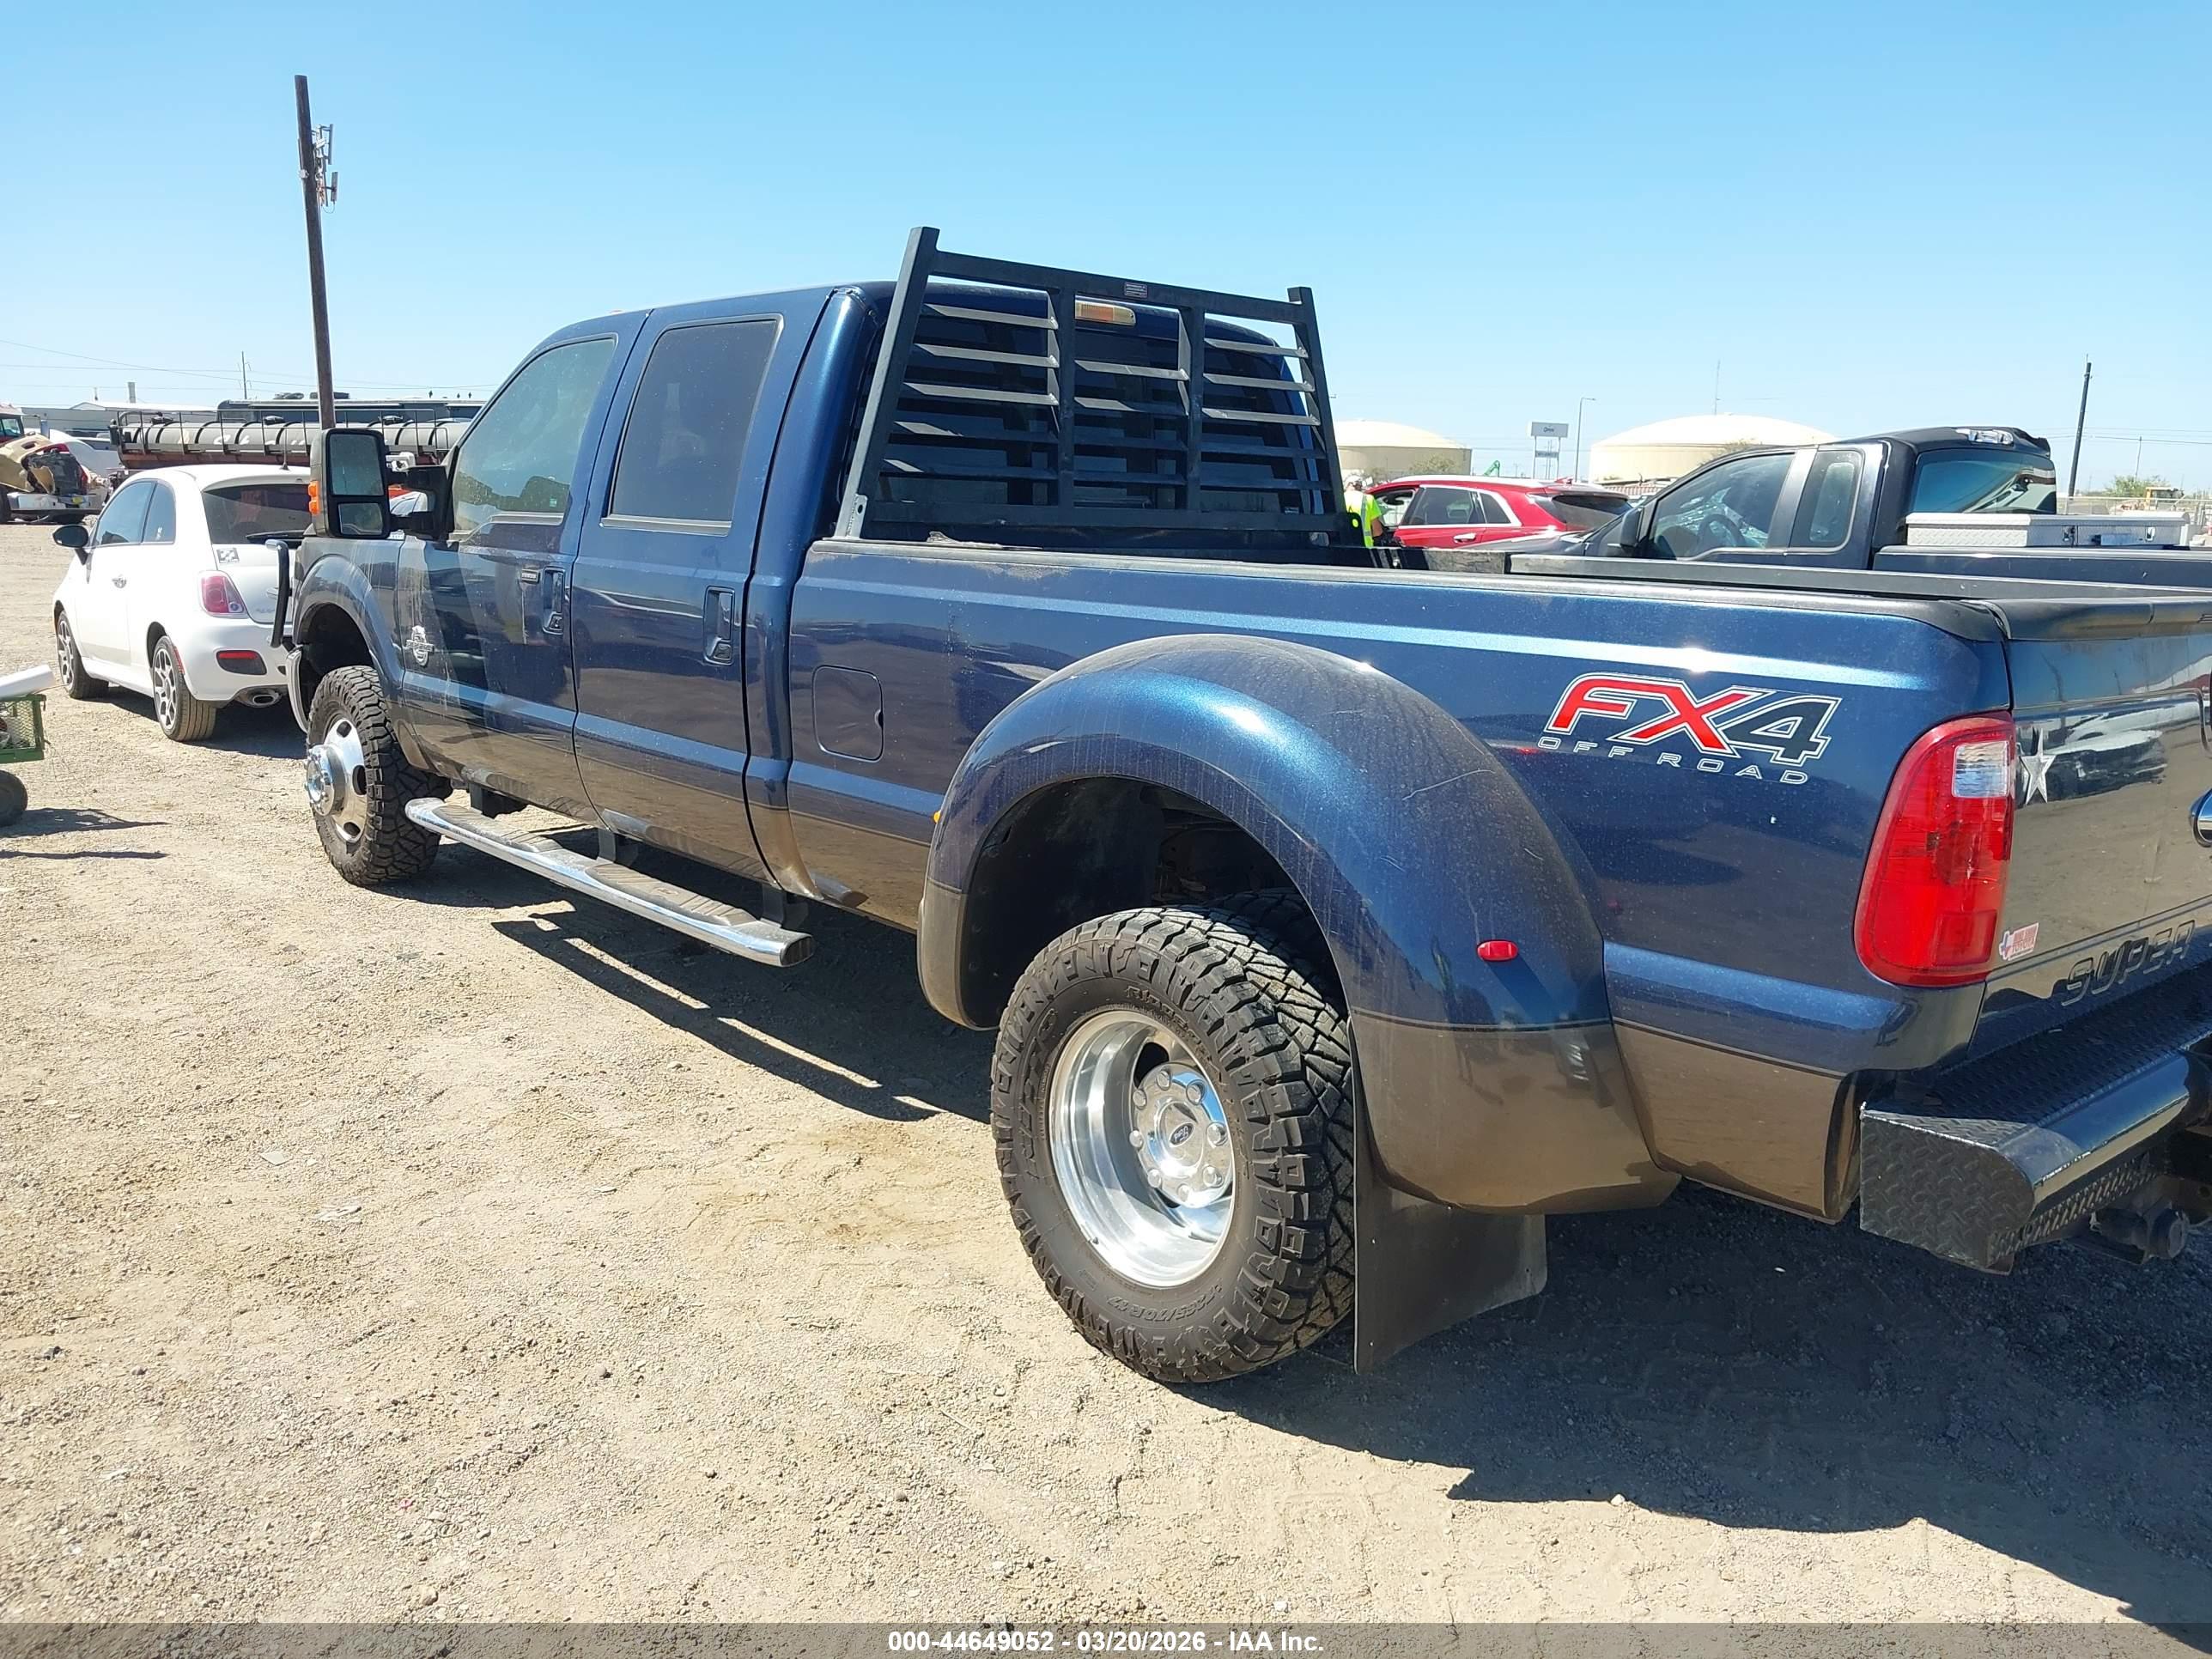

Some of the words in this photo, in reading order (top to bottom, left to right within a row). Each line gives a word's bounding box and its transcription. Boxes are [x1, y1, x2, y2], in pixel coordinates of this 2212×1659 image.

[1537, 735, 1634, 759] OFF
[1656, 752, 1808, 786] ROAD
[1543, 672, 1843, 768] FX4
[2062, 920, 2196, 1006] SUPER
